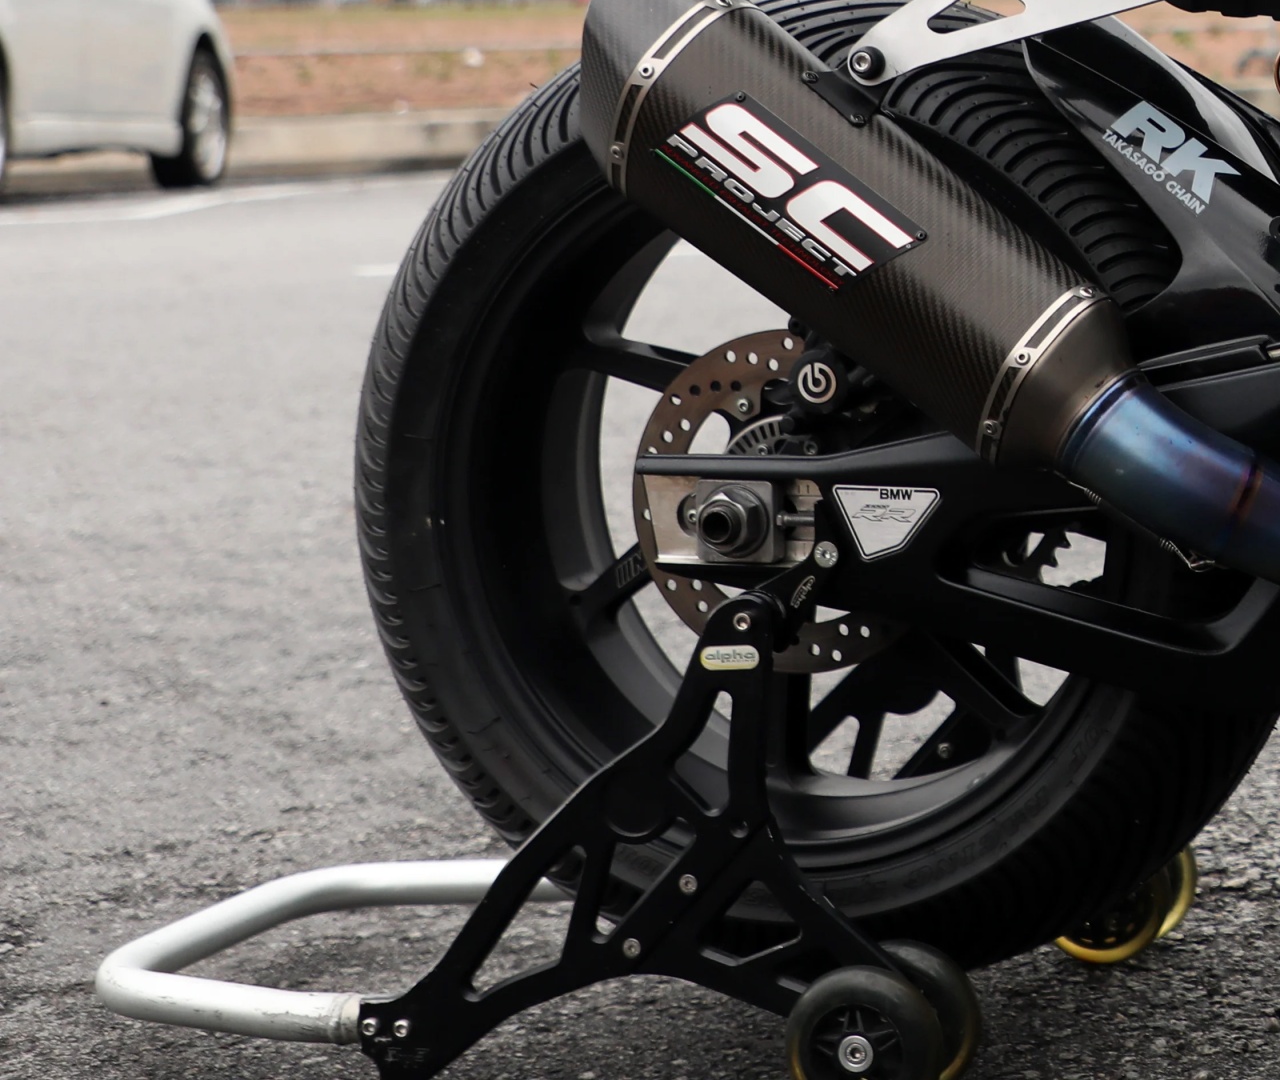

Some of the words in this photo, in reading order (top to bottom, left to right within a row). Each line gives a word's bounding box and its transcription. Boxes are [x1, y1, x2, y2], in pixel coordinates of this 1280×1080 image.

[679, 103, 914, 272] SC
[1102, 128, 1167, 183] TAKASAGO
[1165, 180, 1206, 215] CHAIN
[1110, 100, 1242, 205] RK
[666, 133, 857, 277] PROJECT
[880, 488, 913, 501] BMW
[704, 649, 756, 661] alpha
